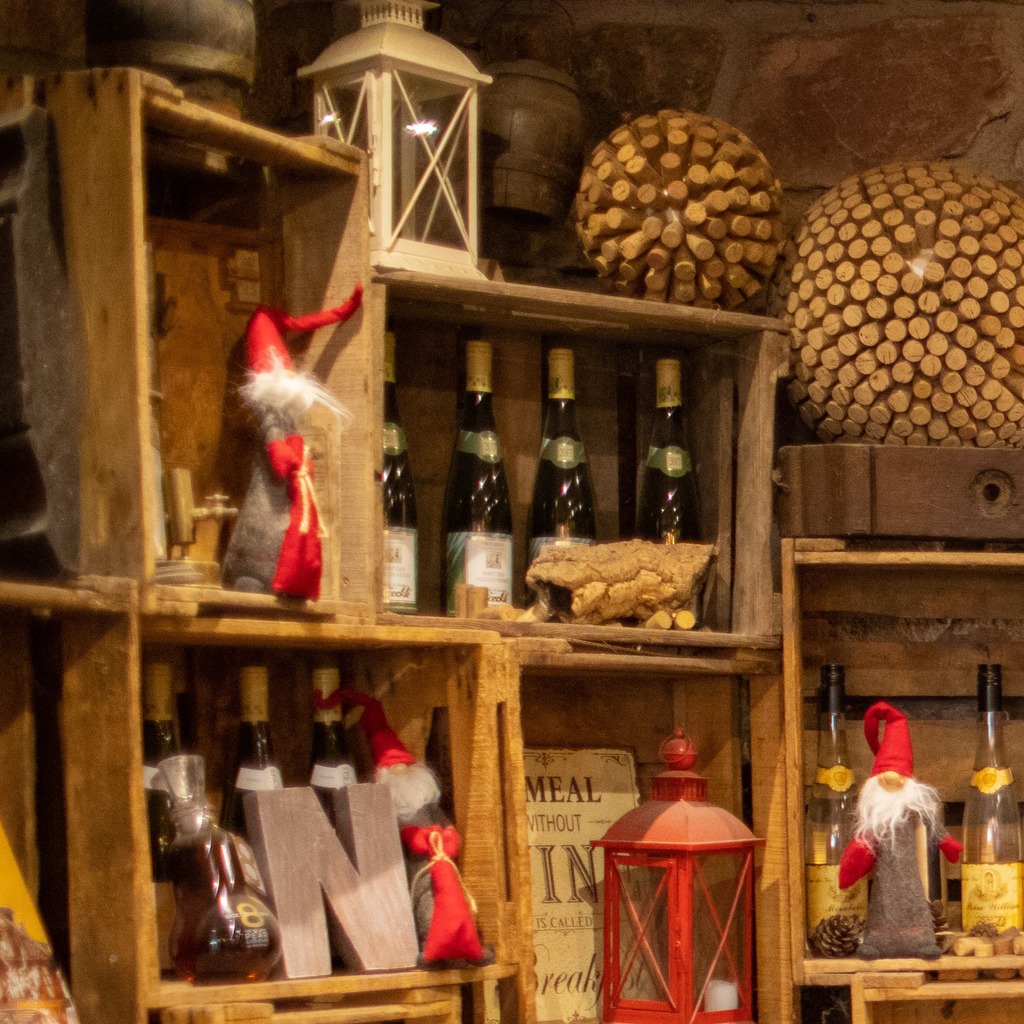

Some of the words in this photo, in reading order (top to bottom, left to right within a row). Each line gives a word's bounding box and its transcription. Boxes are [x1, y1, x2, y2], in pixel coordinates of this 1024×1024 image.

[525, 776, 602, 803] MEAL
[242, 782, 419, 979] N
[536, 917, 547, 929] IS
[549, 915, 594, 929] CALLED
